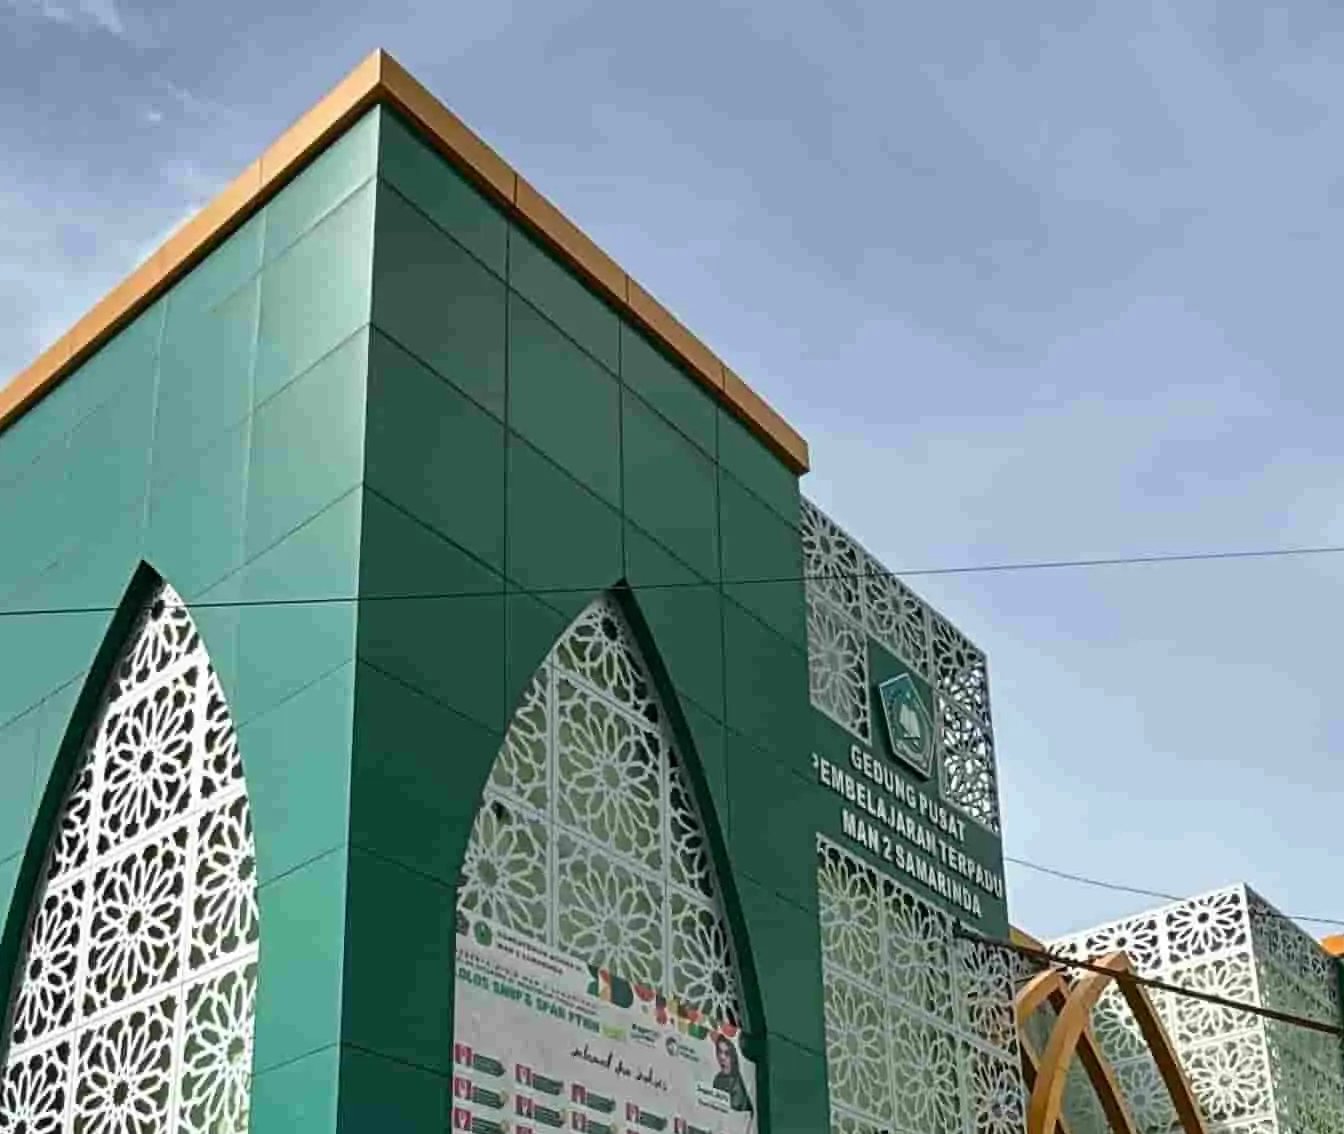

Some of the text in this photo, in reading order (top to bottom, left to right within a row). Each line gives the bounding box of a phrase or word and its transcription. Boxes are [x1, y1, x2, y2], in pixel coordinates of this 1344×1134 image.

[850, 745, 967, 841] GEDUNG PUSAT
[842, 808, 983, 918] MAN 2 SAMARINDA
[938, 839, 1003, 899] TERPADU
